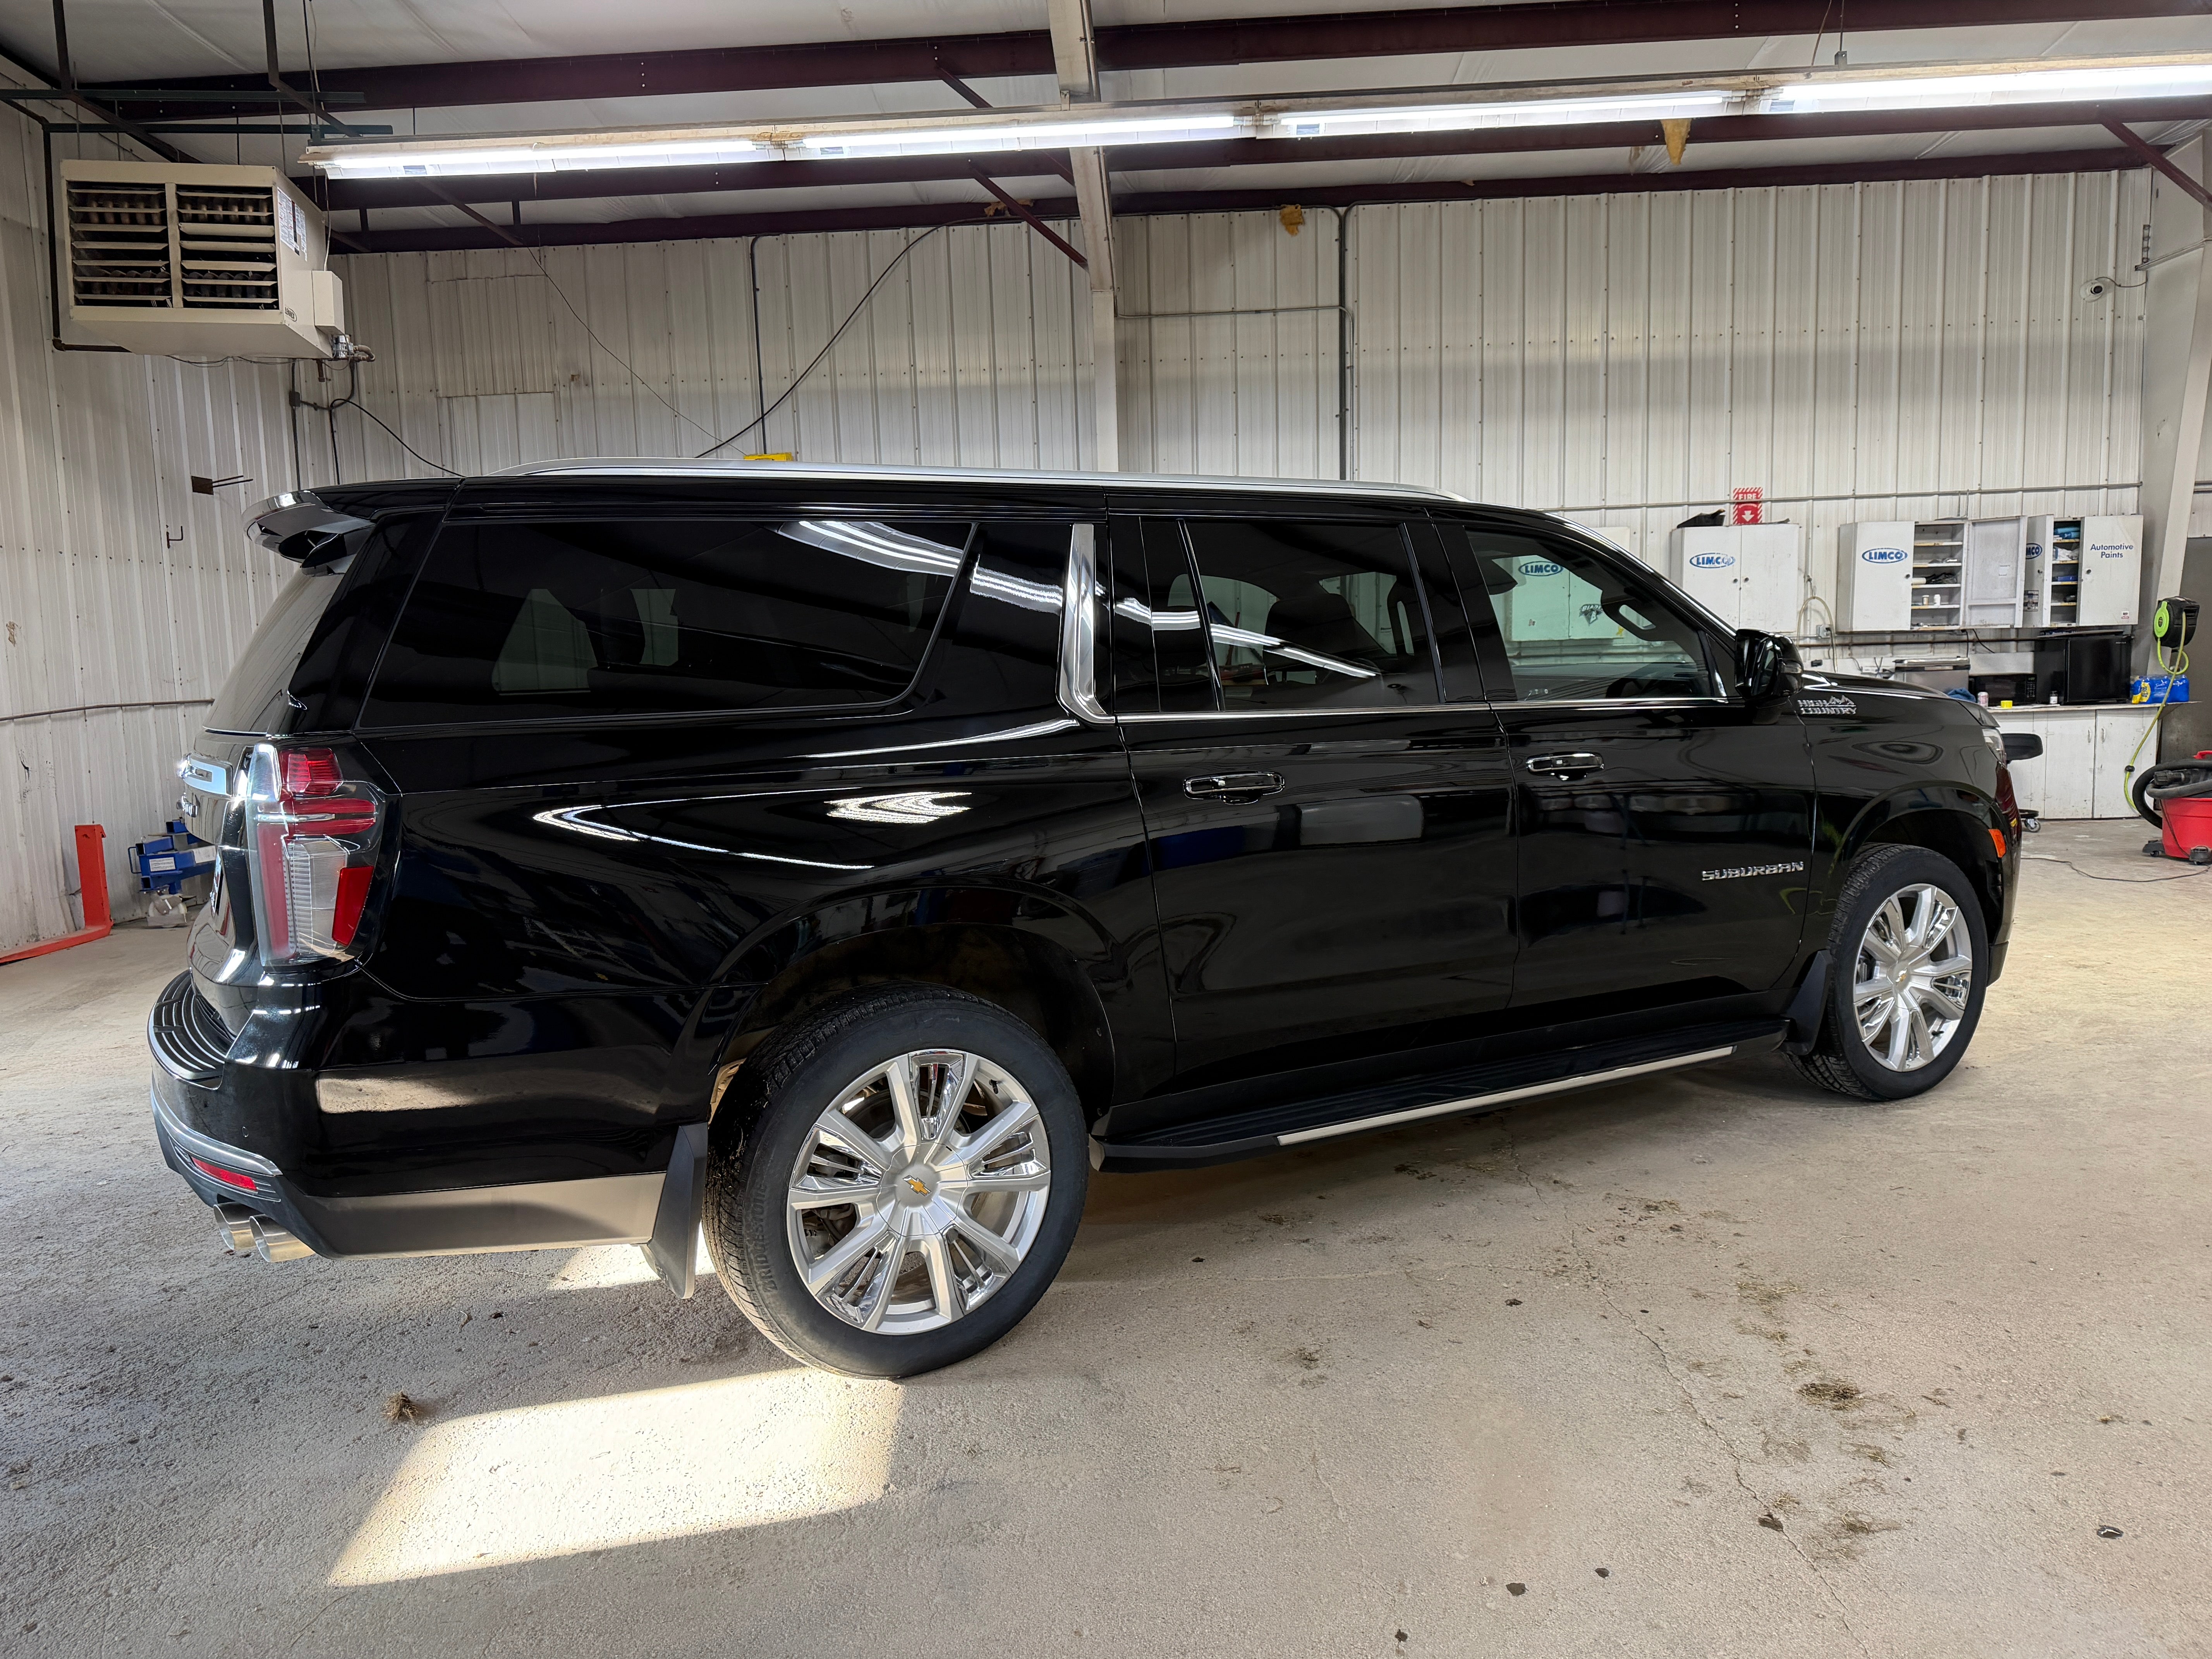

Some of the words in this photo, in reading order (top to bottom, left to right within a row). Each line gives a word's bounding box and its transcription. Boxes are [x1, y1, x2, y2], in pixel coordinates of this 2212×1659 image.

[2026, 546, 2040, 555] MCO
[1869, 551, 1903, 560] LIMCO
[1696, 556, 1731, 565] LIMCO
[1525, 564, 1559, 573] LIMCO
[1702, 861, 1803, 881] SUBURBAN
